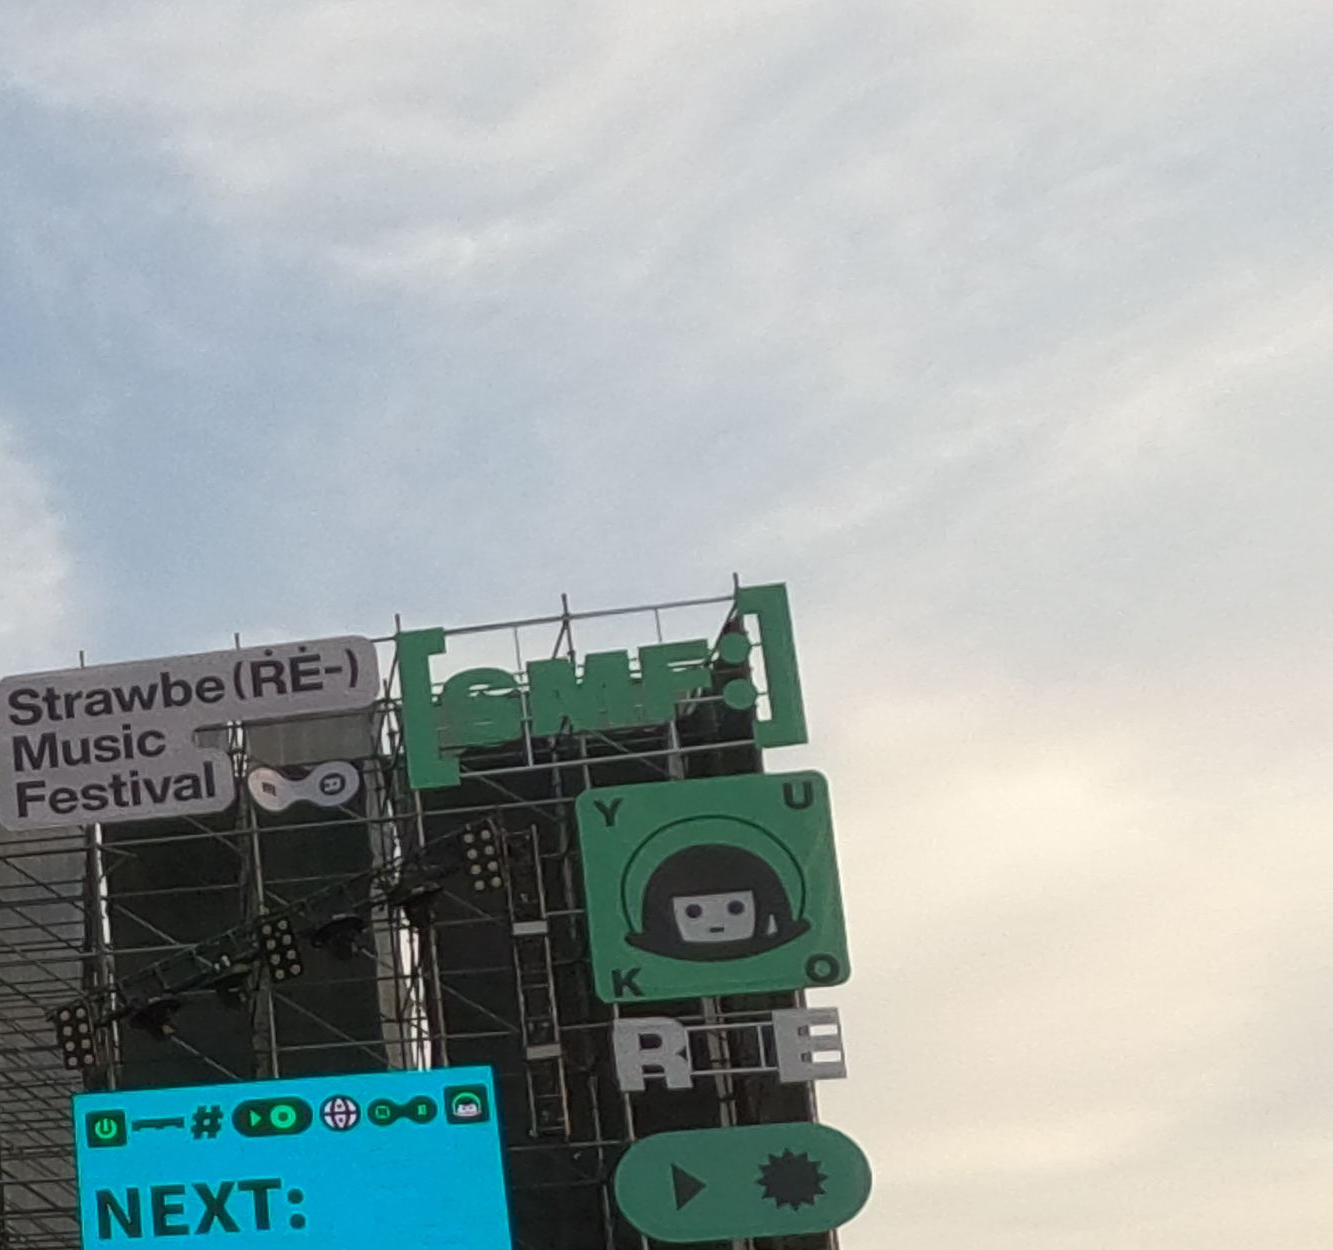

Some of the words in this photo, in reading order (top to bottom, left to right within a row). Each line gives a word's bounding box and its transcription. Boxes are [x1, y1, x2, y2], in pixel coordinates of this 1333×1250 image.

[11, 722, 166, 774] Music
[16, 762, 217, 820] Festival
[594, 798, 623, 827] Y
[782, 781, 814, 810] U
[611, 967, 645, 998] K
[95, 1178, 307, 1240] NEXT:
